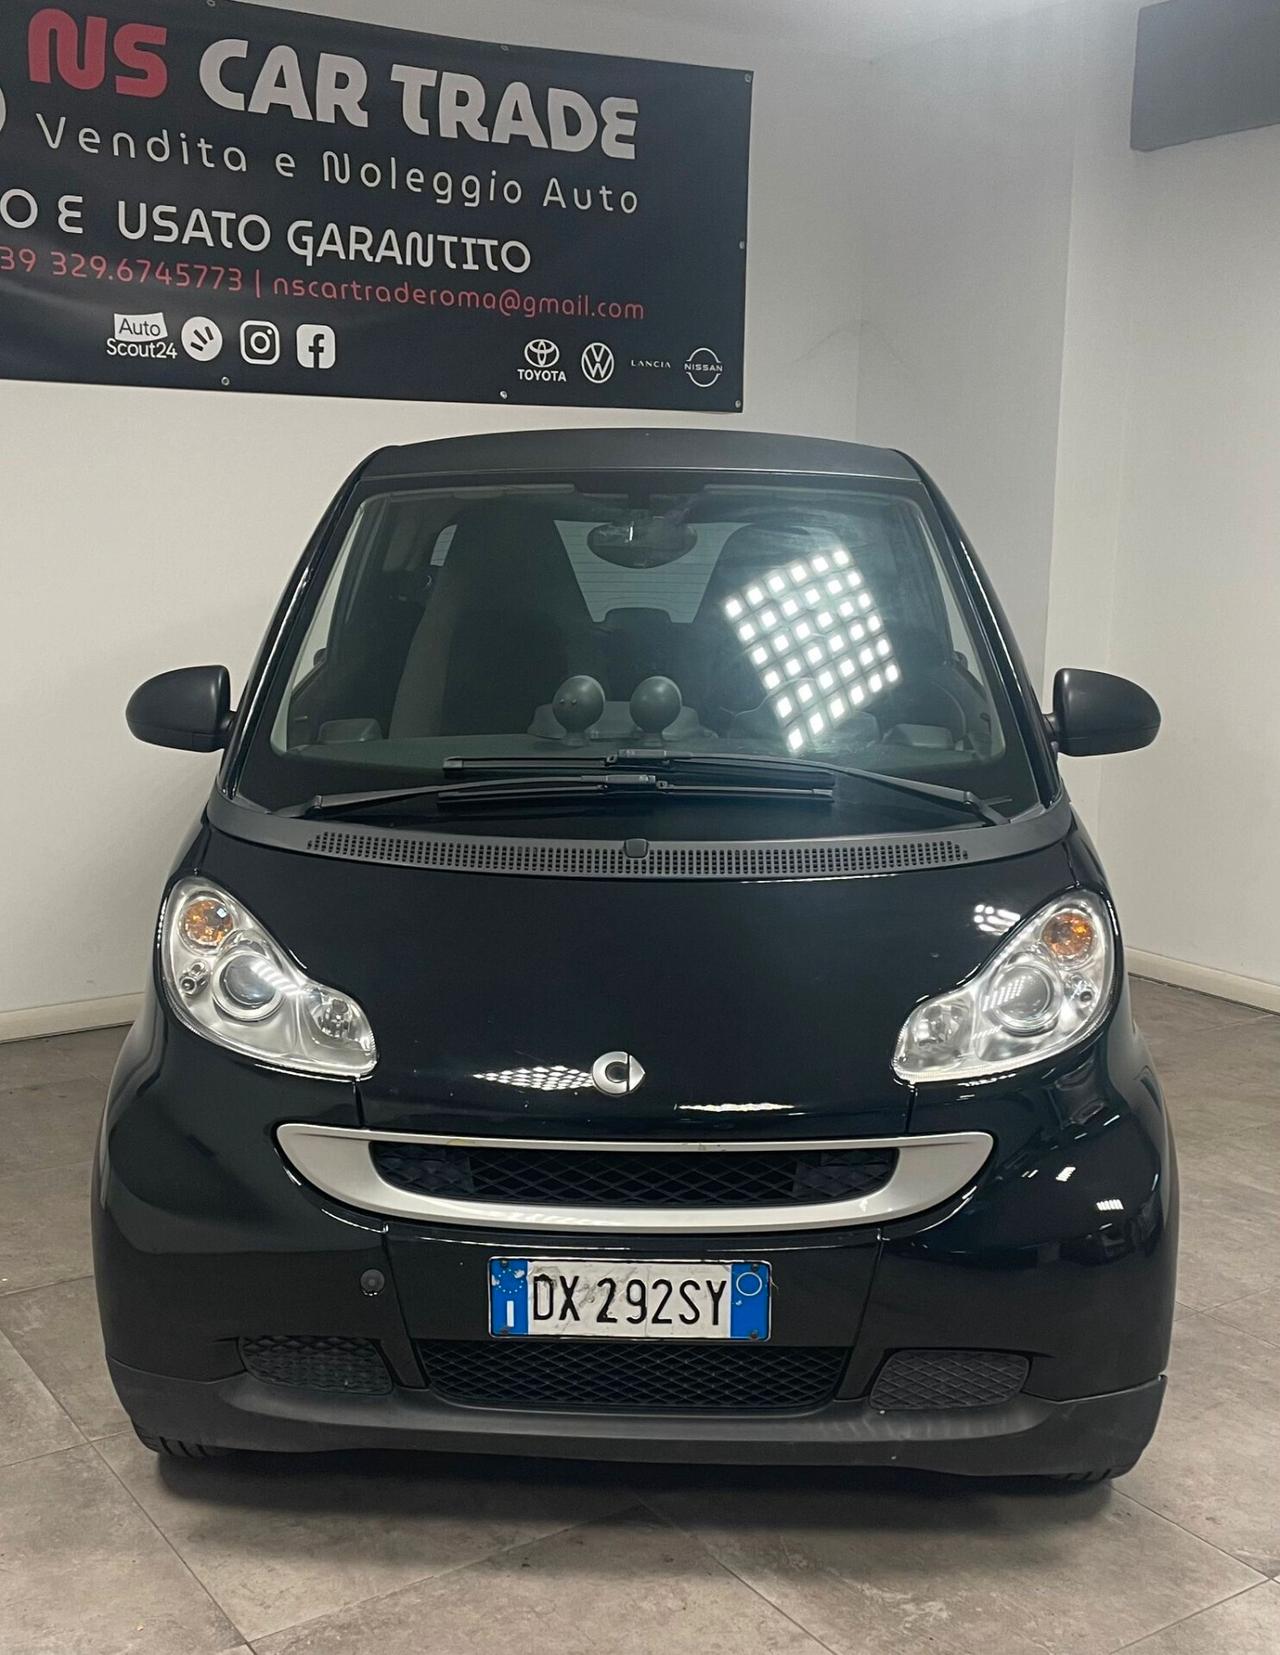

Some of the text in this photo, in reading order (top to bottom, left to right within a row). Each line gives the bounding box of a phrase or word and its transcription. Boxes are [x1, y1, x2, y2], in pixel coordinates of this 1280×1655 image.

[28, 8, 639, 160] NS CAR TRADE
[36, 113, 638, 214] Vendita e Noleggio Auto
[58, 195, 83, 234] E
[118, 200, 271, 252] USATO
[287, 220, 531, 273] GARANTITO
[50, 251, 243, 292] 329.6745773
[273, 277, 645, 320] nscartraderoma@gmail.com
[118, 318, 161, 337] Auto
[106, 338, 178, 360] Scout24
[631, 359, 671, 368] LANCIA
[684, 363, 722, 372] NISSAN
[517, 368, 567, 382] TOYOTA
[533, 1273, 727, 1326] DX 292SY
